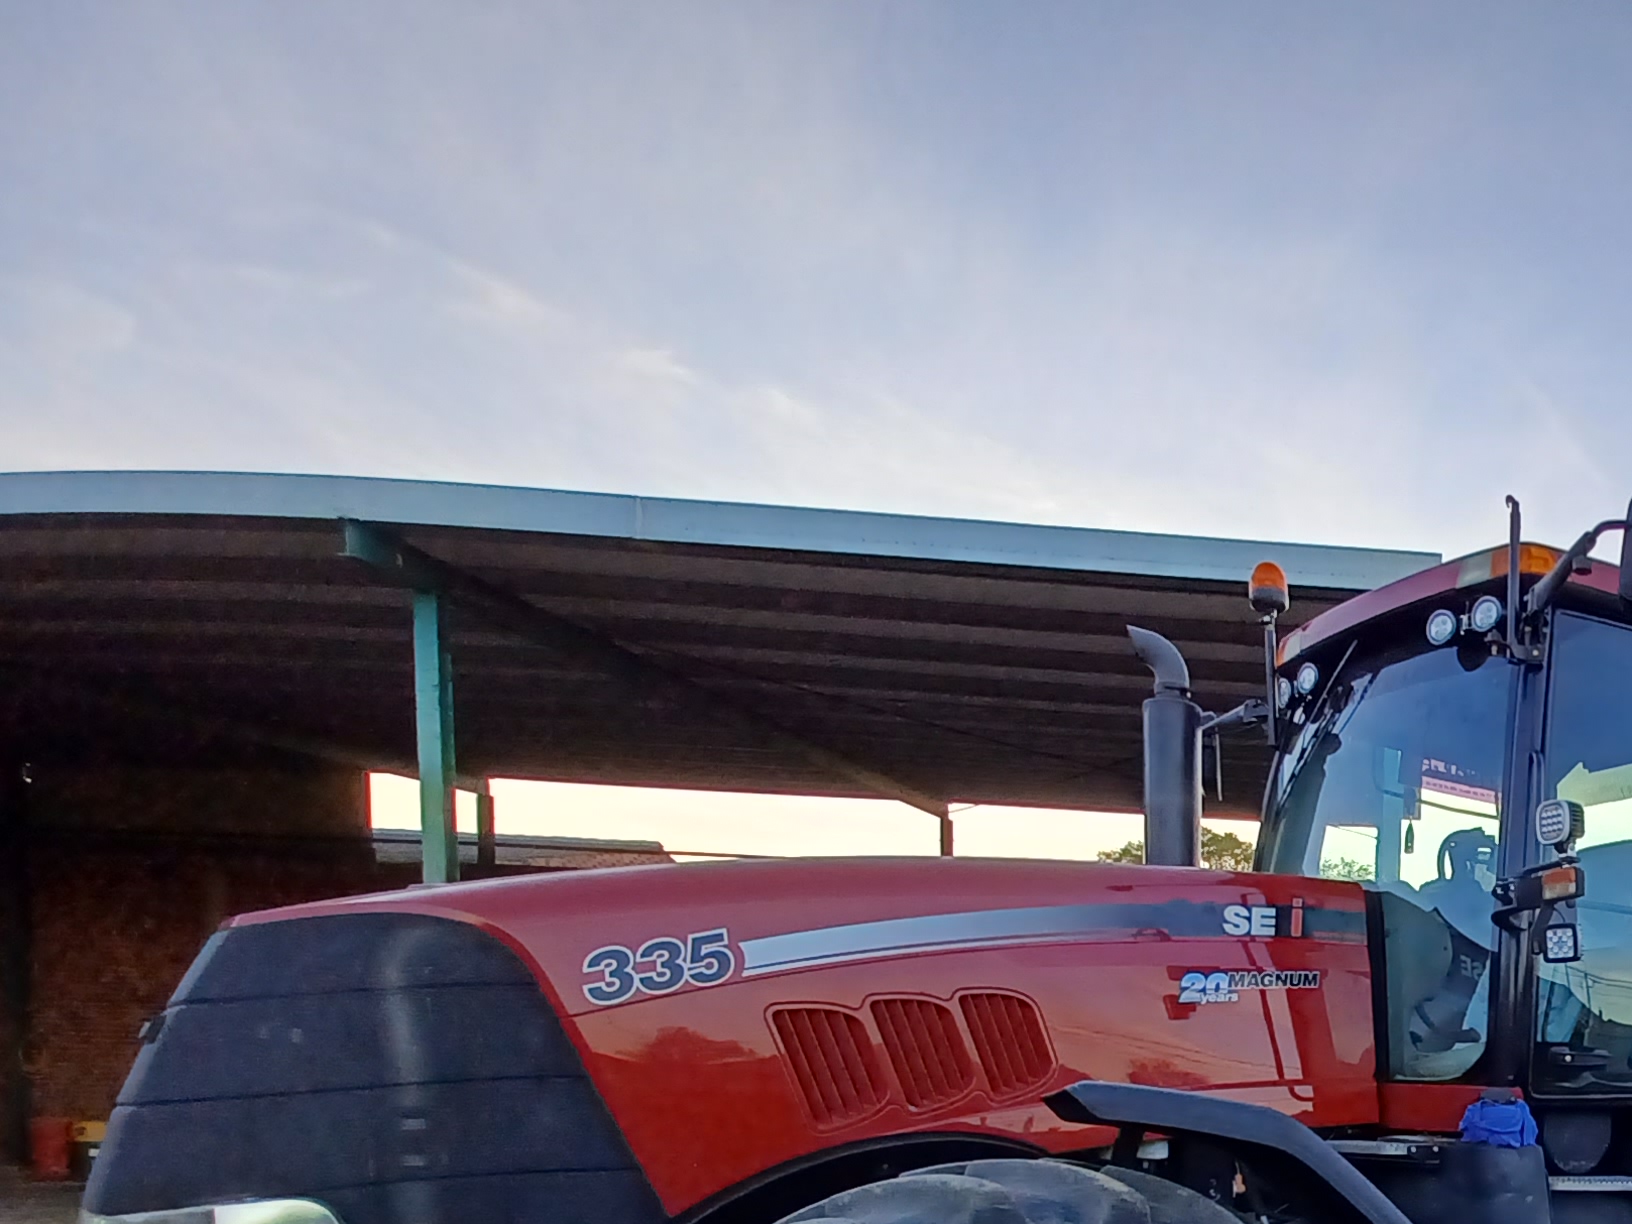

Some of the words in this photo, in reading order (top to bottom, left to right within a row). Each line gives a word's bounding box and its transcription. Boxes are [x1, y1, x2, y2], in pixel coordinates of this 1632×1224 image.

[1222, 905, 1276, 936] SE
[582, 928, 734, 1005] 335
[1178, 972, 1229, 1003] 20
[1227, 971, 1320, 989] MAGNUM
[1200, 993, 1239, 1005] years
